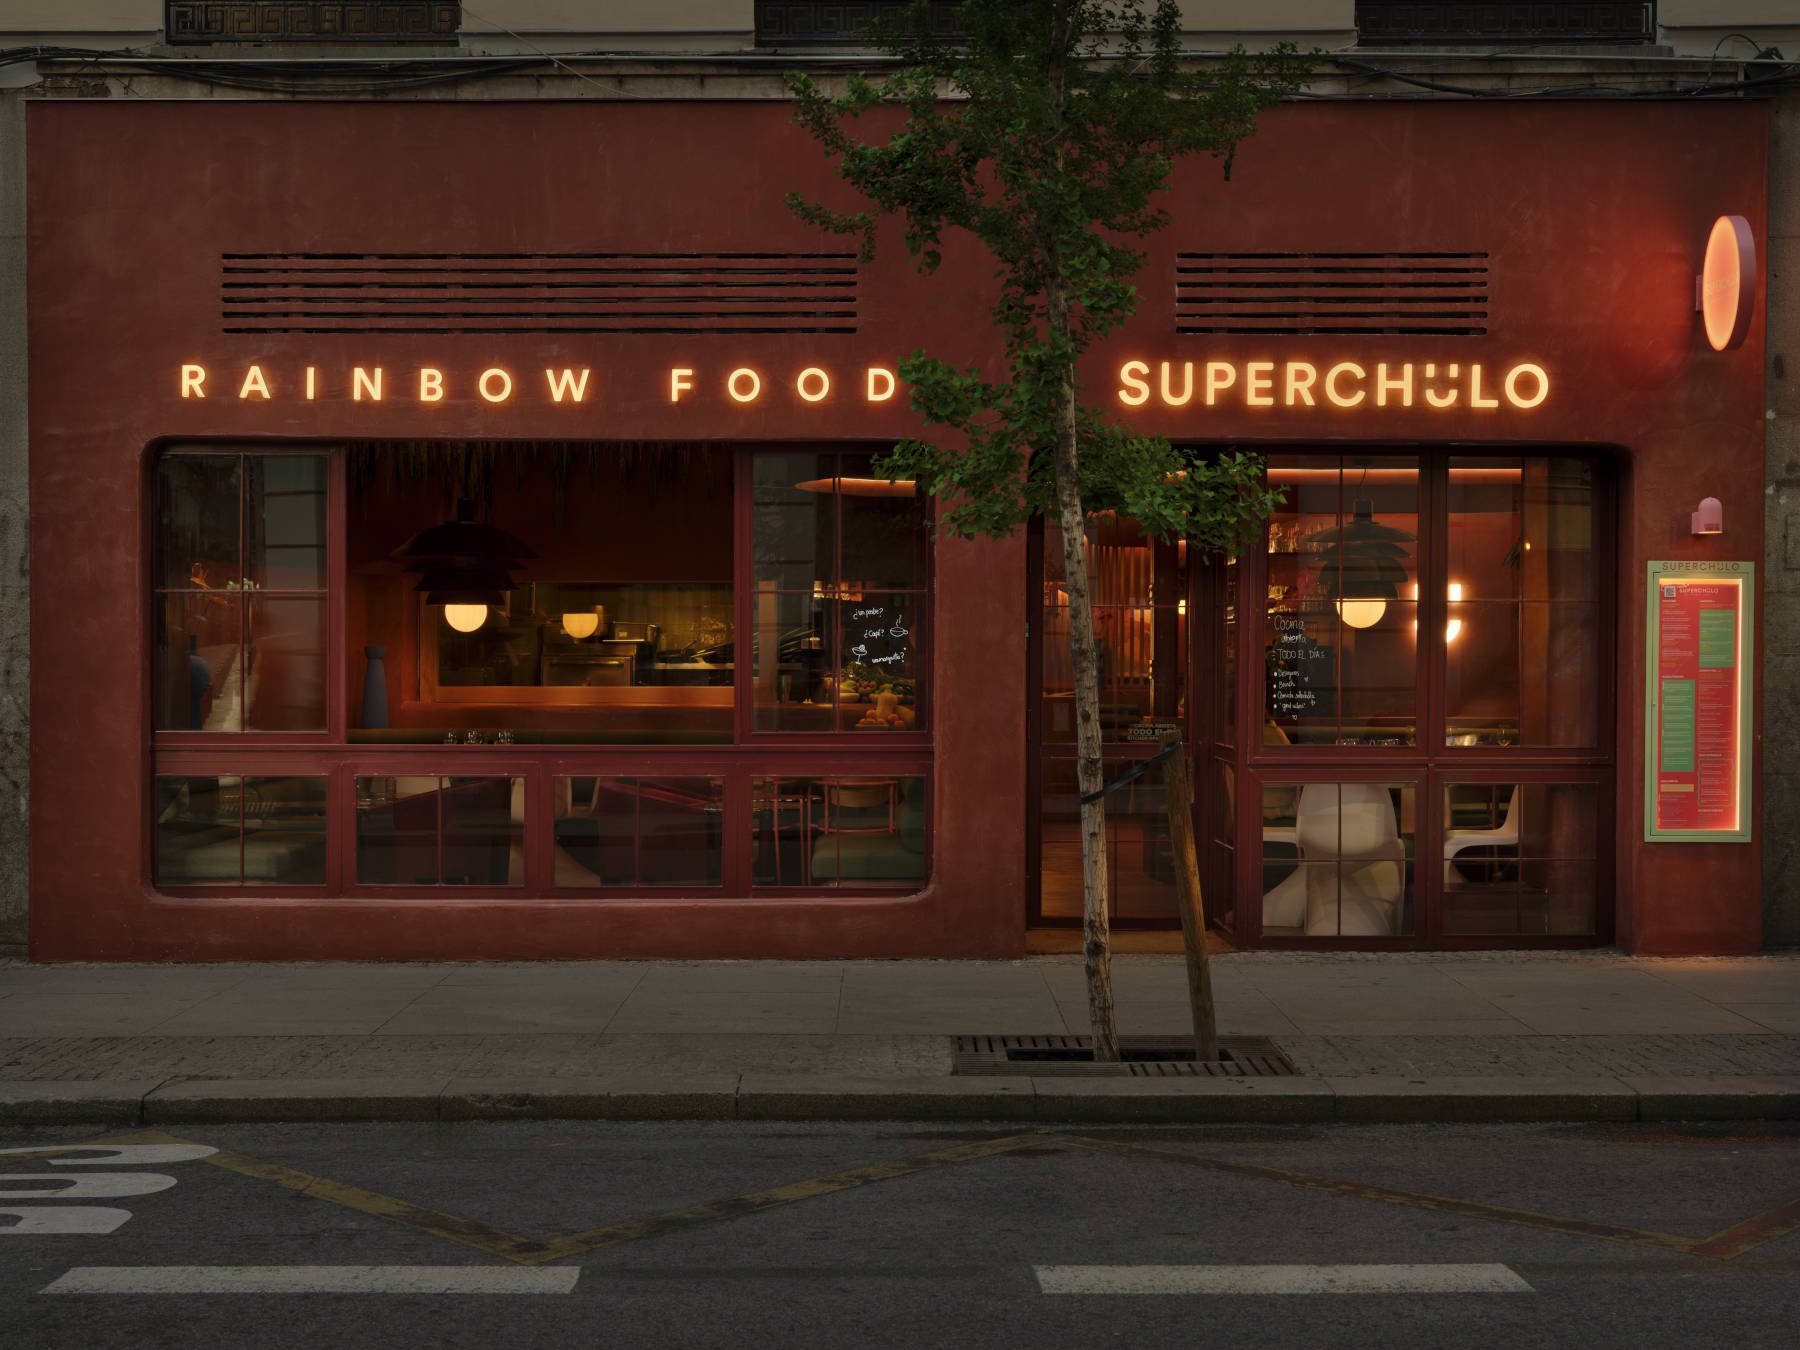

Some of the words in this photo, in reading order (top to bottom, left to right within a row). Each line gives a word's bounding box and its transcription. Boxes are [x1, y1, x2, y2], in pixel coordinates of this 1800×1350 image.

[180, 364, 590, 403] RAINBOW
[670, 367, 896, 403] FOOD
[1274, 615, 1304, 630] Cocina
[1276, 648, 1296, 660] TODO
